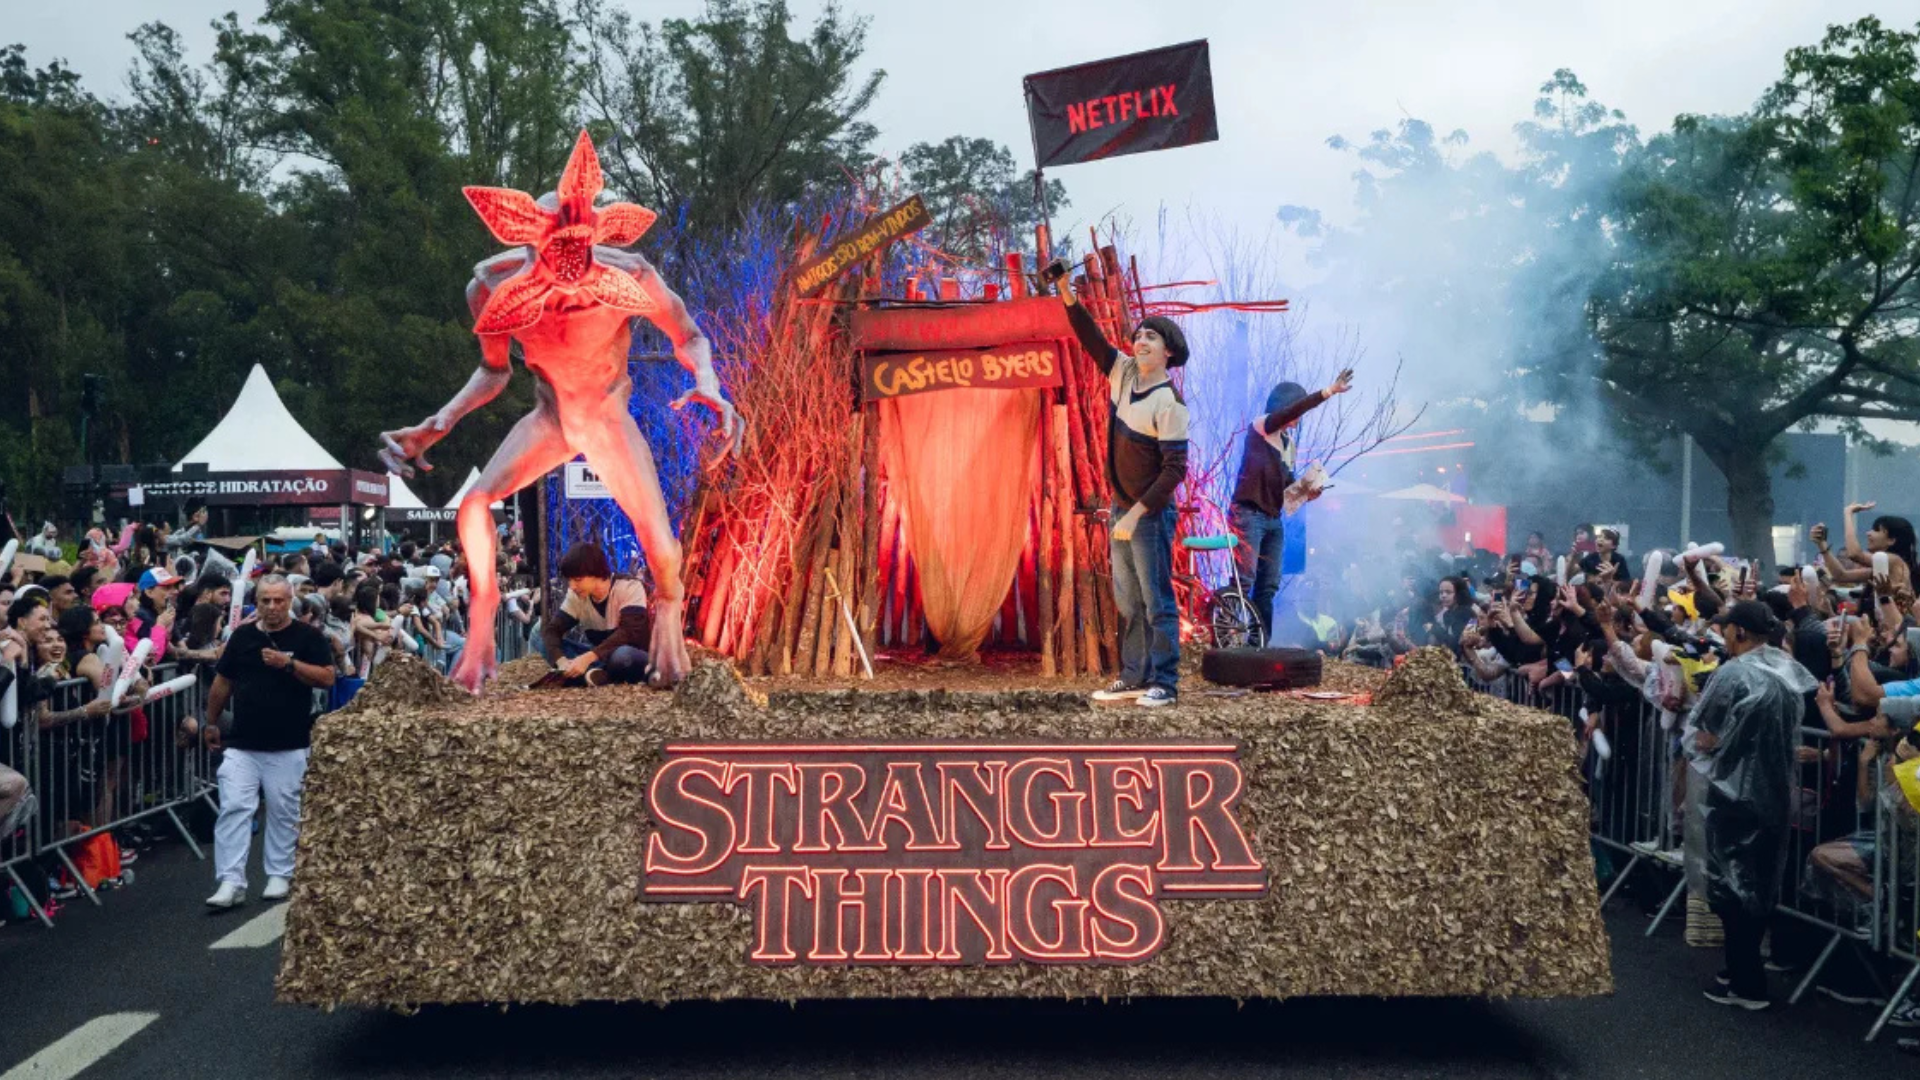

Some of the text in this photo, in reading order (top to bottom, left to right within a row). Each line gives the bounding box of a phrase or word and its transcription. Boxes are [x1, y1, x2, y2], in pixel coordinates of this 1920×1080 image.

[1066, 84, 1179, 135] NETFLIX
[796, 256, 839, 294] AMIGOS
[980, 350, 1054, 381] BYERS
[193, 481, 217, 495] DE
[219, 477, 328, 496] HIDRATAÇÃO
[406, 508, 458, 520] SAÍDA 07
[643, 757, 1264, 875] STRANGER
[738, 863, 1167, 962] THINGS
